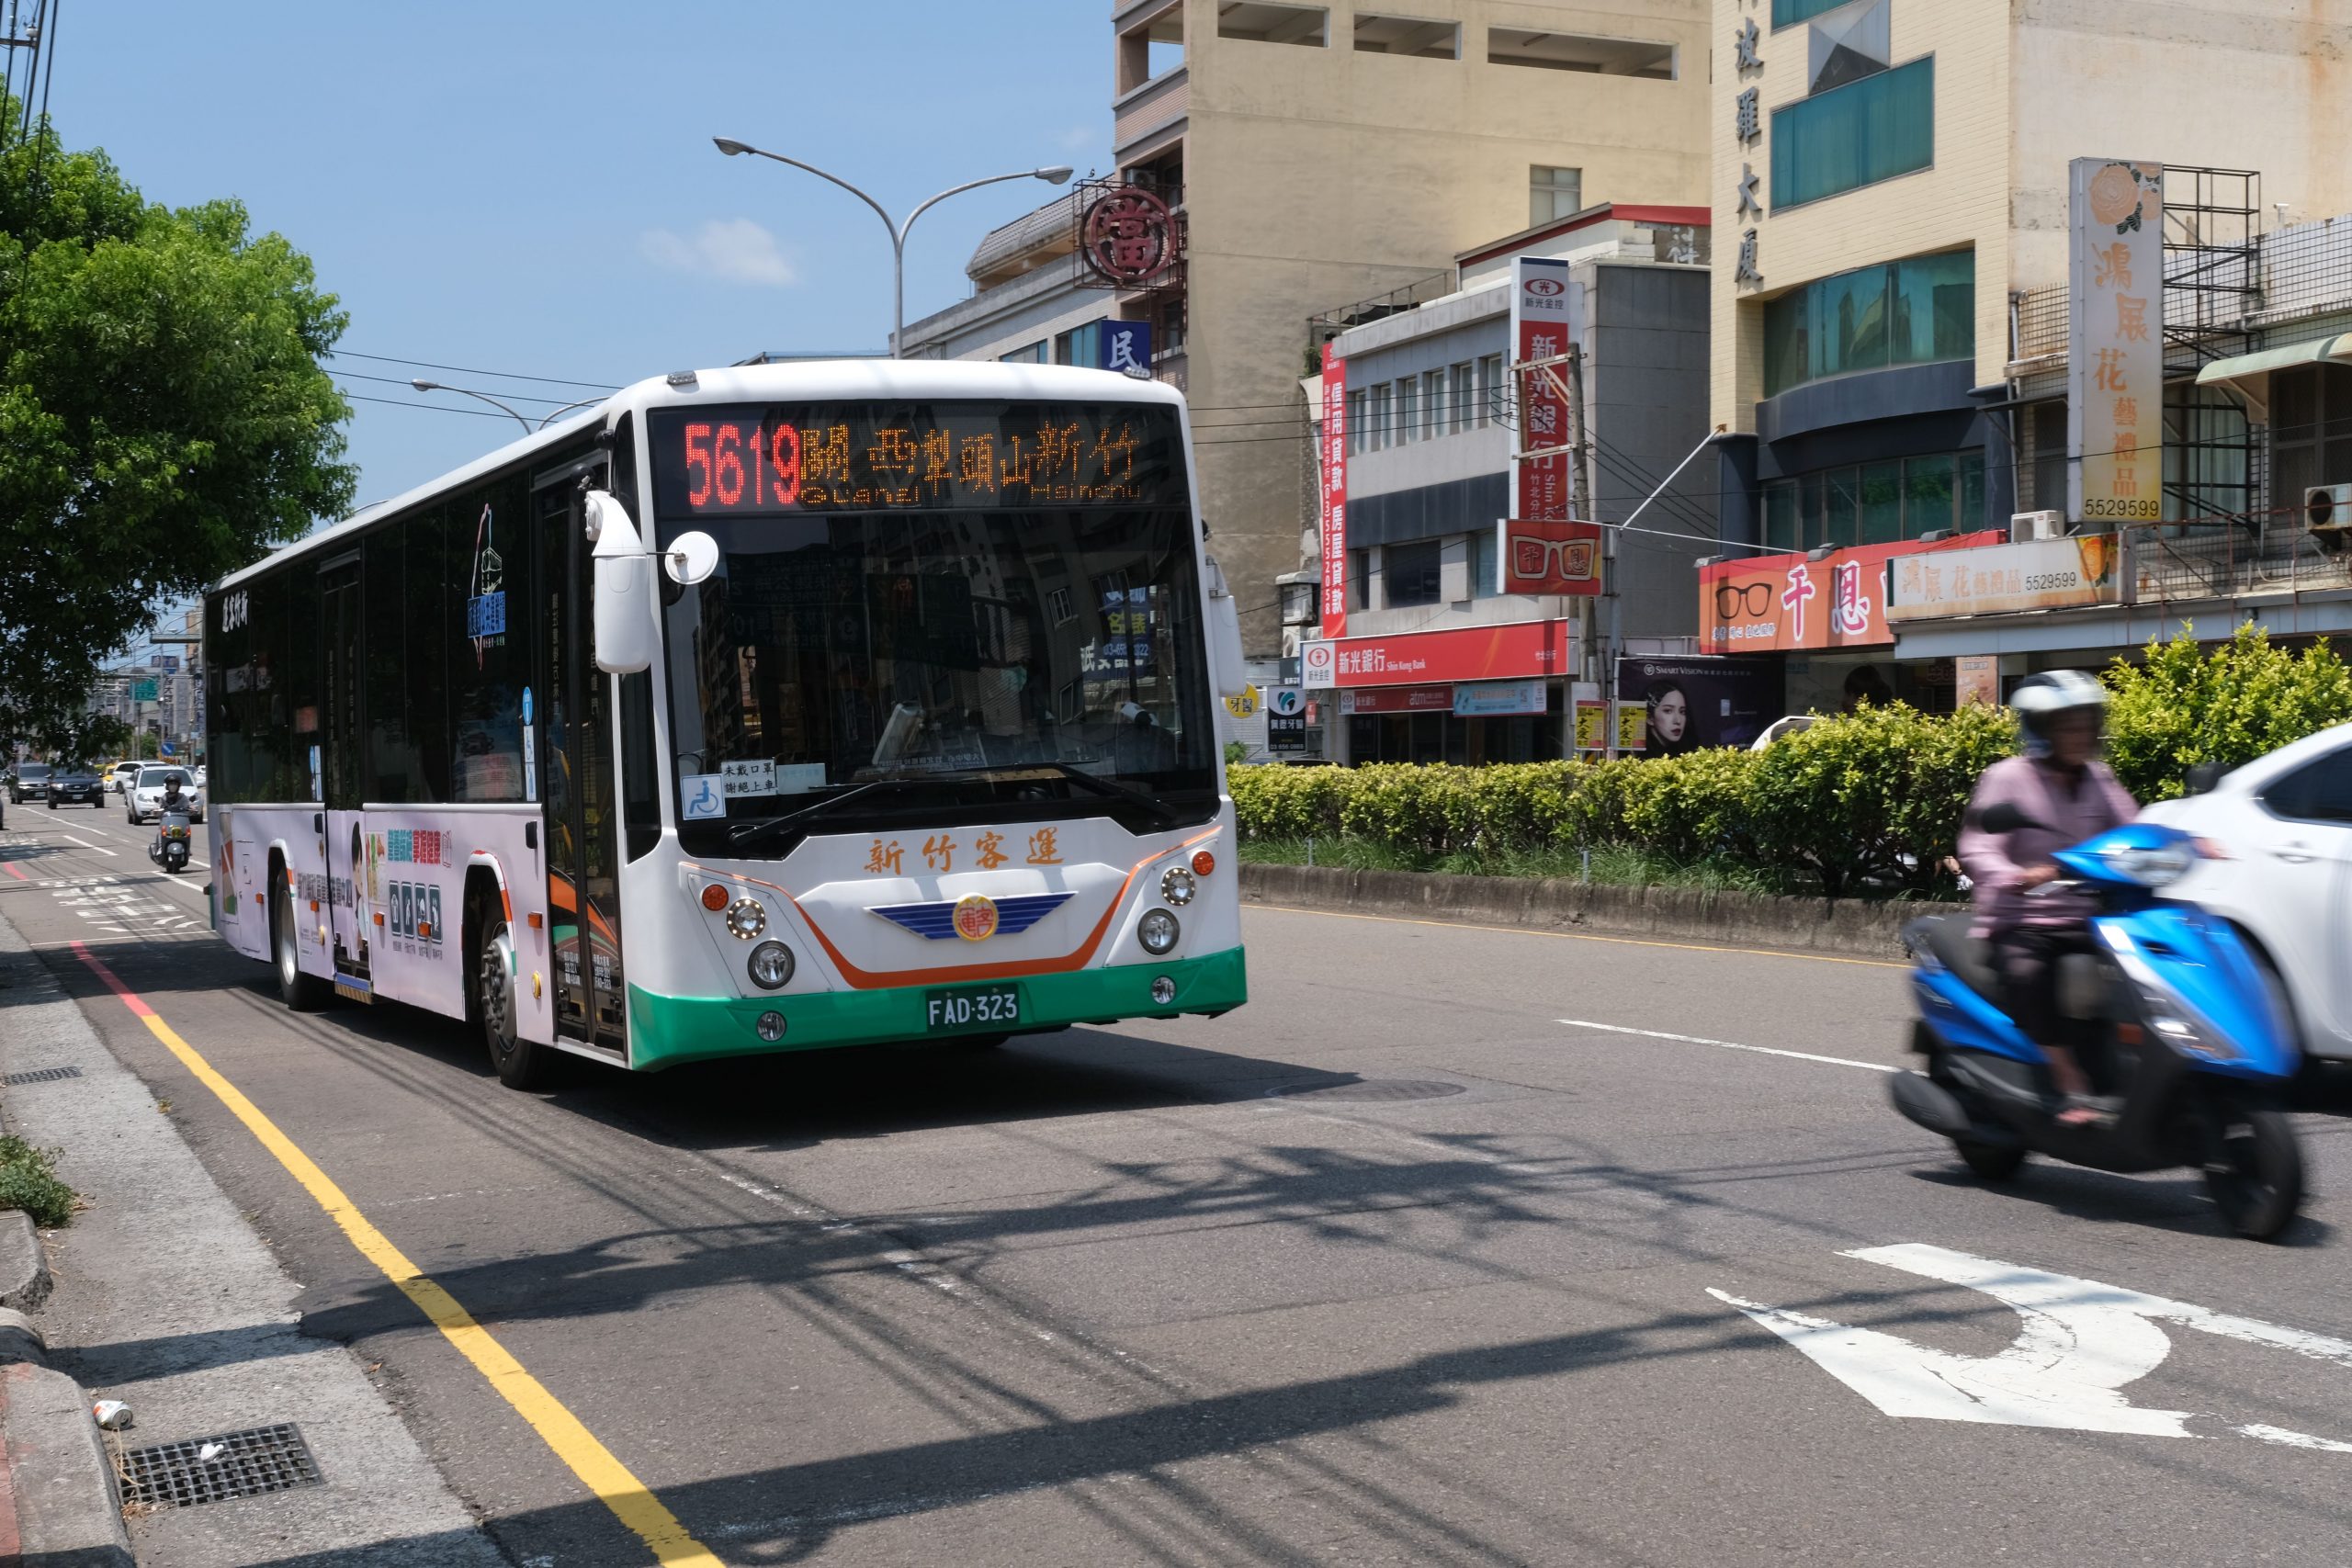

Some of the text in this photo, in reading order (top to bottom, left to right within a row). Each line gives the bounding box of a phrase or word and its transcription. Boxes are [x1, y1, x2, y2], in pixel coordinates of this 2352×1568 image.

[1734, 0, 1765, 284] 波羅大廈
[1109, 330, 1143, 368] 民
[1331, 381, 1343, 492] 信用貸款
[685, 423, 800, 506] 5619
[2084, 498, 2159, 517] 5529599
[1331, 504, 1343, 615] 房屋貸款
[2026, 570, 2077, 592] 5529599
[1781, 559, 1888, 642] 千恩
[1339, 649, 1385, 675] 新光銀行
[1386, 660, 1426, 672] Shin Kong Bank
[1230, 697, 1253, 713] 牙醫
[724, 761, 774, 777] 未戴口罩
[724, 779, 775, 794] 謝絕上車
[864, 827, 1064, 875] 新竹客運
